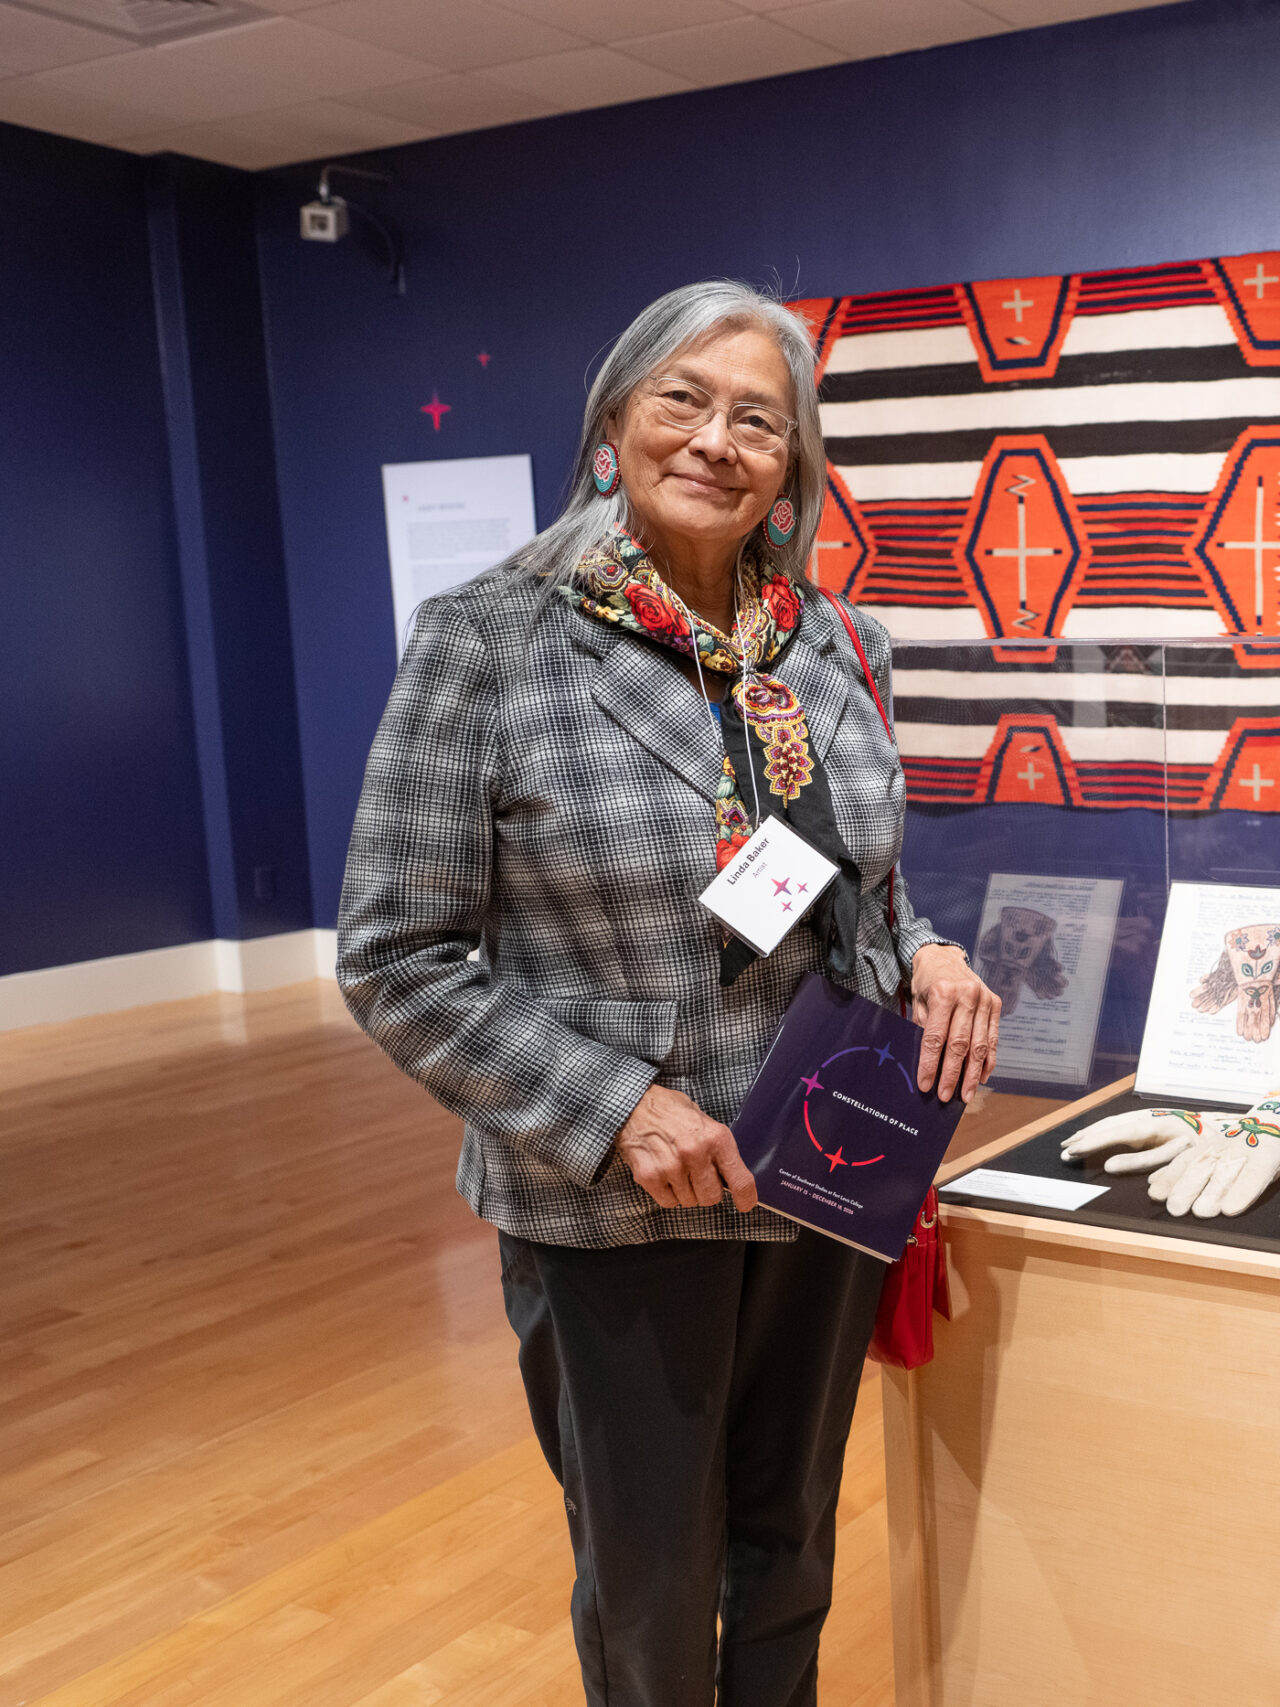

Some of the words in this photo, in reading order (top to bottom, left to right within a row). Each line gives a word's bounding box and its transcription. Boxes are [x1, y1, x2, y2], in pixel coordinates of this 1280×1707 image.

[727, 861, 750, 885] Linda
[746, 838, 770, 862] Baker
[752, 862, 768, 878] Artist
[832, 1090, 889, 1122] CONSTELLATIONS
[889, 1118, 898, 1126] OF
[899, 1122, 919, 1136] PLACE
[779, 1168, 791, 1177] Center
[815, 1184, 827, 1193] Studies
[840, 1195, 850, 1203] Lewis
[850, 1199, 863, 1209] College
[781, 1180, 803, 1192] JANUARY
[812, 1193, 837, 1207] DECEMBER
